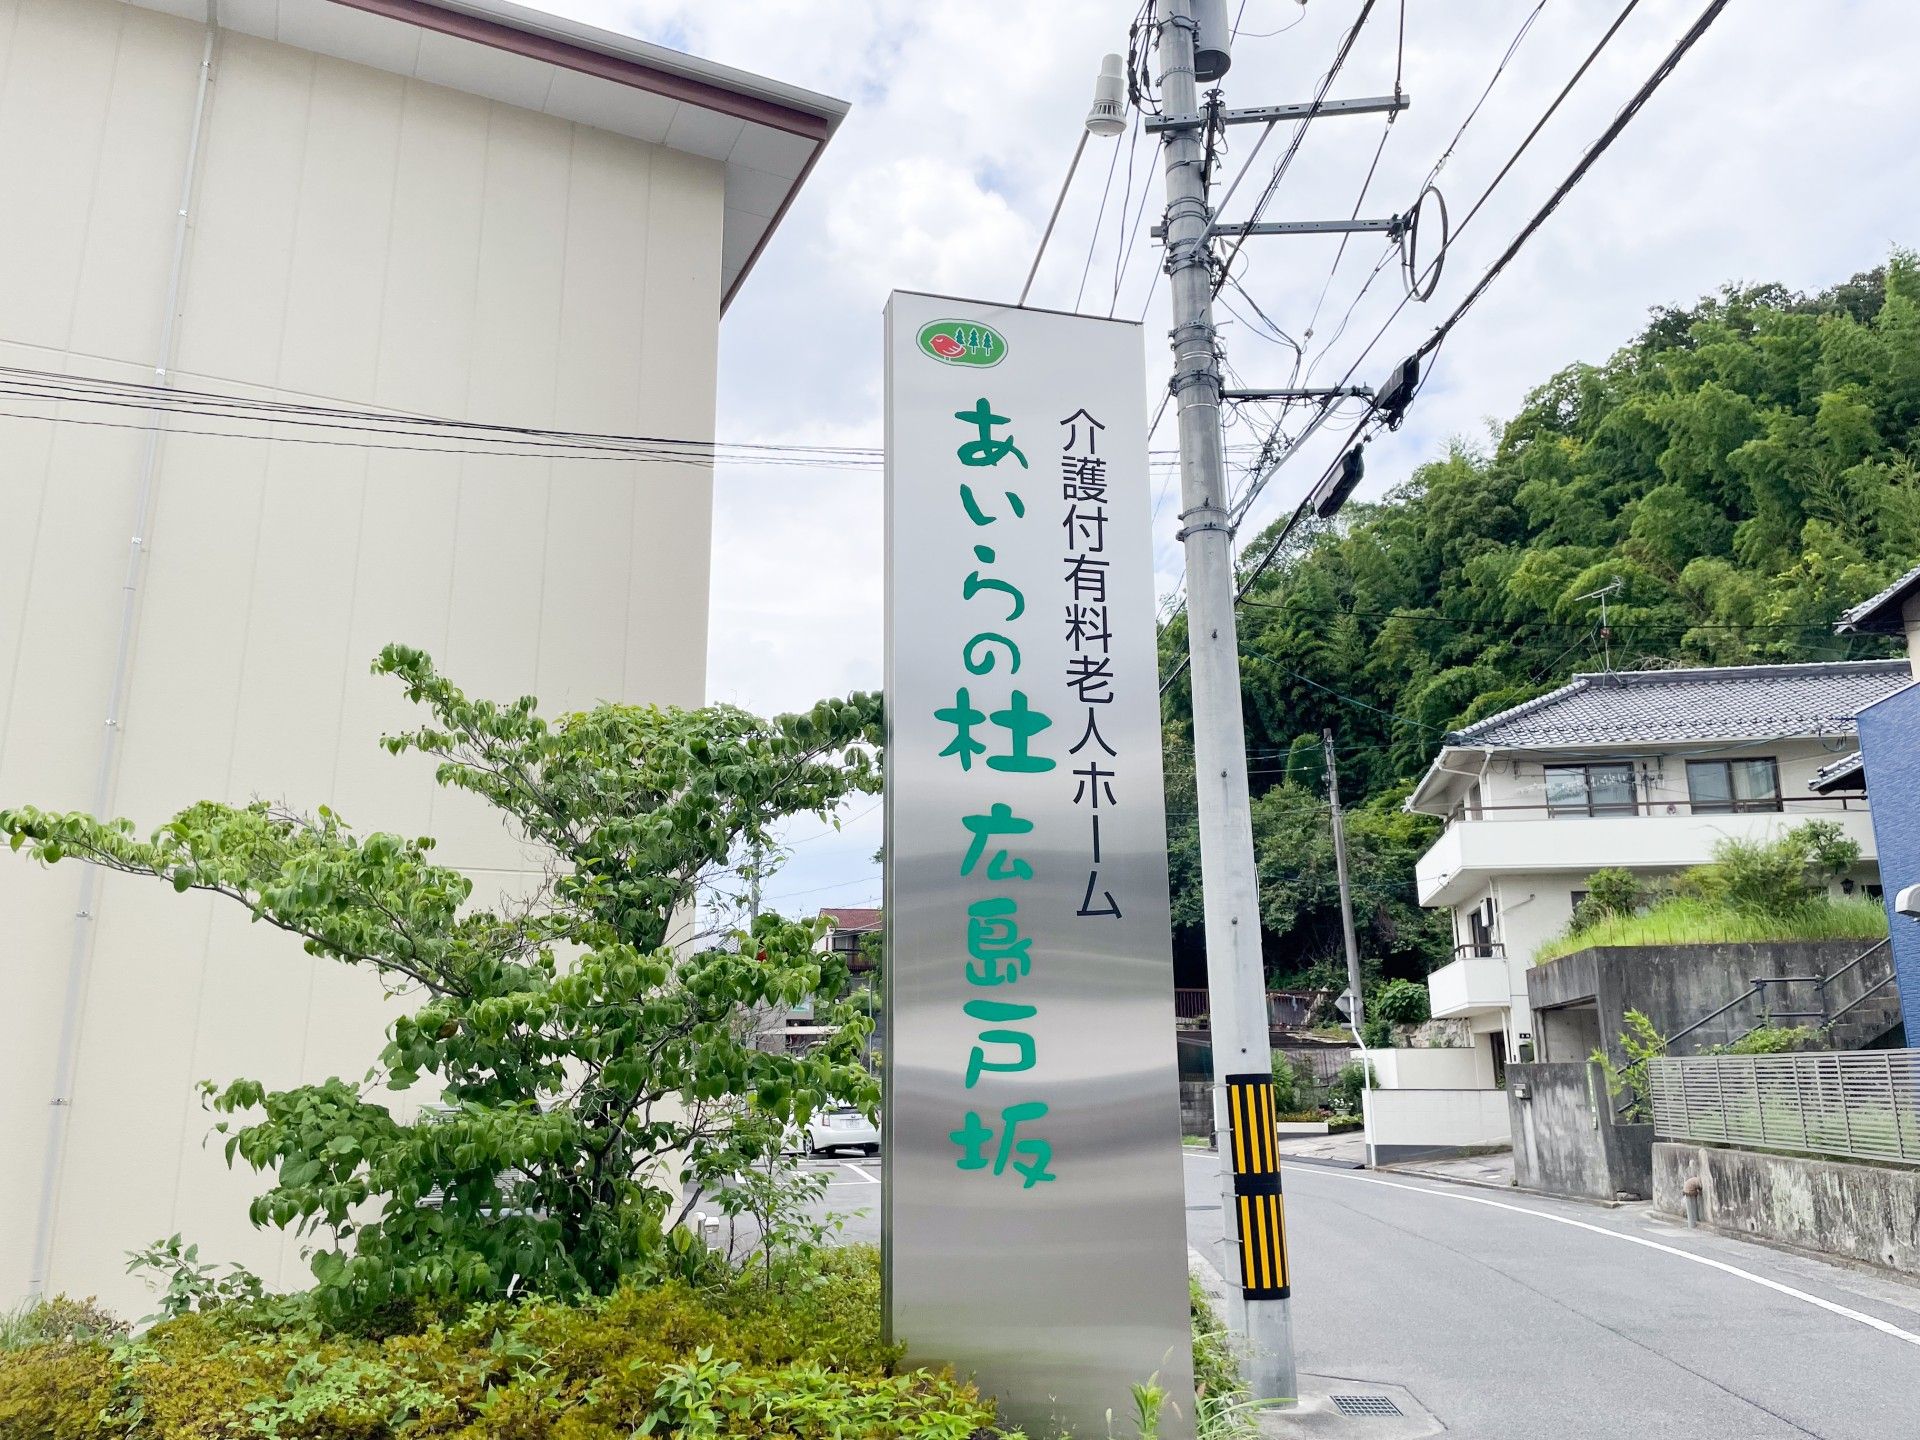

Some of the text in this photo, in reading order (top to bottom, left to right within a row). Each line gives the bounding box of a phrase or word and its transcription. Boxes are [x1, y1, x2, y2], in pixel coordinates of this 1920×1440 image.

[934, 398, 1057, 1188] あいらの杜 広島戸坂
[1060, 408, 1122, 919] 介護付有料老人ホーム
